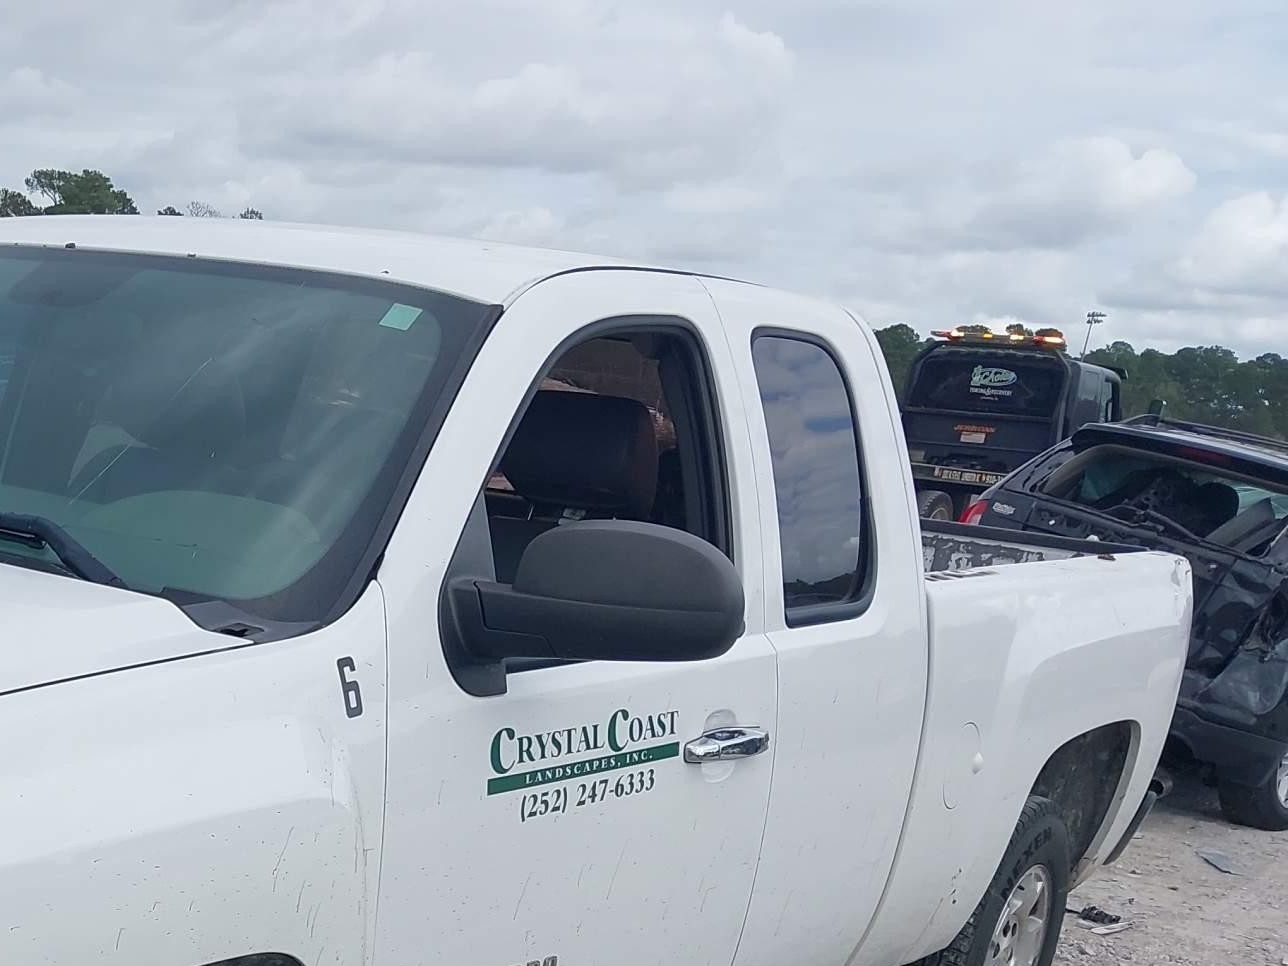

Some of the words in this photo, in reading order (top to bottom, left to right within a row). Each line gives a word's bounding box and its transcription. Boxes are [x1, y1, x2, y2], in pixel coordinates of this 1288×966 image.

[336, 655, 364, 719] 6
[490, 723, 606, 775] CRYSTAL
[607, 708, 679, 752] COAST
[525, 756, 621, 785] LANDSCAPES,
[626, 750, 653, 764] INC.
[520, 787, 568, 823] (252)
[576, 768, 655, 807] 247-6333
